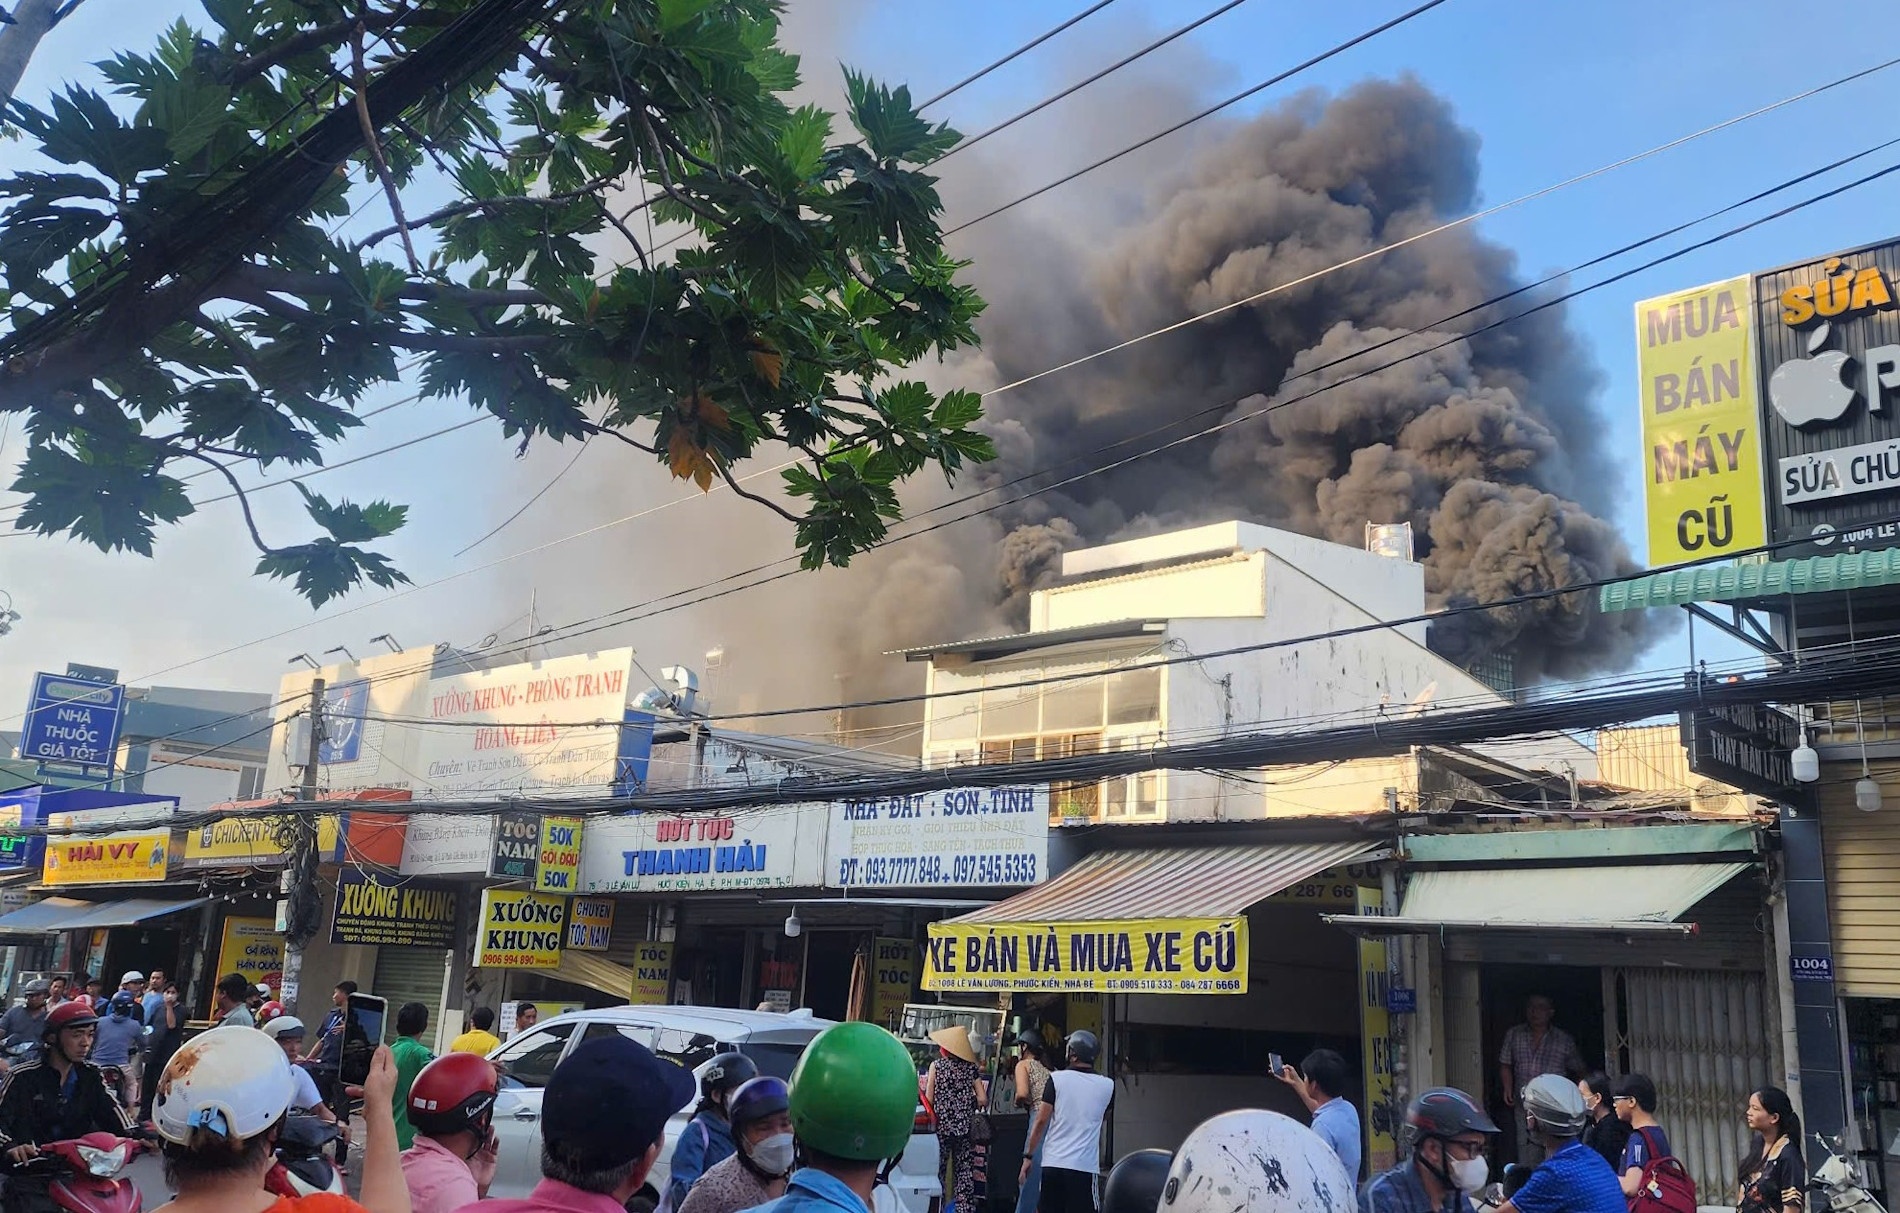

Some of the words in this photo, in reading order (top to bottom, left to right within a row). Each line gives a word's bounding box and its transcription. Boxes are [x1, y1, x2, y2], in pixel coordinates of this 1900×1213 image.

[1781, 257, 1892, 325] SỬA
[1647, 290, 1740, 348] MUA
[1654, 356, 1740, 414] BÁN
[1654, 424, 1745, 484] MÁY
[1785, 456, 1840, 496] SỬA
[1677, 493, 1734, 551] CŨ
[431, 685, 472, 718] XƯỞNG
[473, 684, 516, 712] KHUNG
[525, 673, 572, 704] PHÒNG
[574, 669, 625, 698] TRANH
[58, 708, 91, 724] NHÀ
[45, 722, 98, 742] THUỐC
[474, 719, 520, 751] HOÀNG
[38, 741, 65, 758] GIÁ
[70, 742, 98, 760] TỐT
[1710, 729, 1737, 767] THAY
[214, 822, 261, 844] CHICKEN
[503, 818, 537, 839] TÓC
[549, 827, 574, 846] 50K
[68, 841, 103, 862] HẢI
[108, 842, 139, 860] VY
[497, 841, 537, 859] NAM
[622, 847, 711, 876] THANH
[715, 838, 767, 873] HẢI
[544, 871, 569, 888] 50K
[865, 855, 940, 885] 093.7777.848
[953, 853, 1036, 883] 097.545.5353
[340, 873, 398, 918] XƯỞNG
[401, 888, 457, 921] KHUNG
[491, 895, 562, 924] XƯỞNG
[576, 900, 611, 918] CHUYÊN
[487, 930, 558, 951] KHUNG
[570, 918, 587, 946] TÓC
[589, 927, 610, 948] NAM
[640, 945, 667, 961] TÓC
[928, 936, 956, 973] XE
[965, 928, 1018, 973] BÁN
[1027, 926, 1061, 973] VÀ
[1071, 932, 1133, 973] MUA
[1144, 932, 1182, 973] XE
[1193, 922, 1236, 973] CŨ
[483, 954, 502, 964] 0906
[504, 954, 518, 965] 994
[520, 954, 534, 965] 890
[1793, 959, 1828, 969] 1004
[638, 967, 668, 980] NAM
[879, 966, 909, 984] TÓC
[1065, 977, 1081, 988] NHÀ
[1120, 979, 1139, 989] 0909
[1157, 980, 1173, 989] 333
[1180, 979, 1195, 989] 084
[1198, 979, 1213, 989] 287
[1215, 979, 1240, 990] 6668
